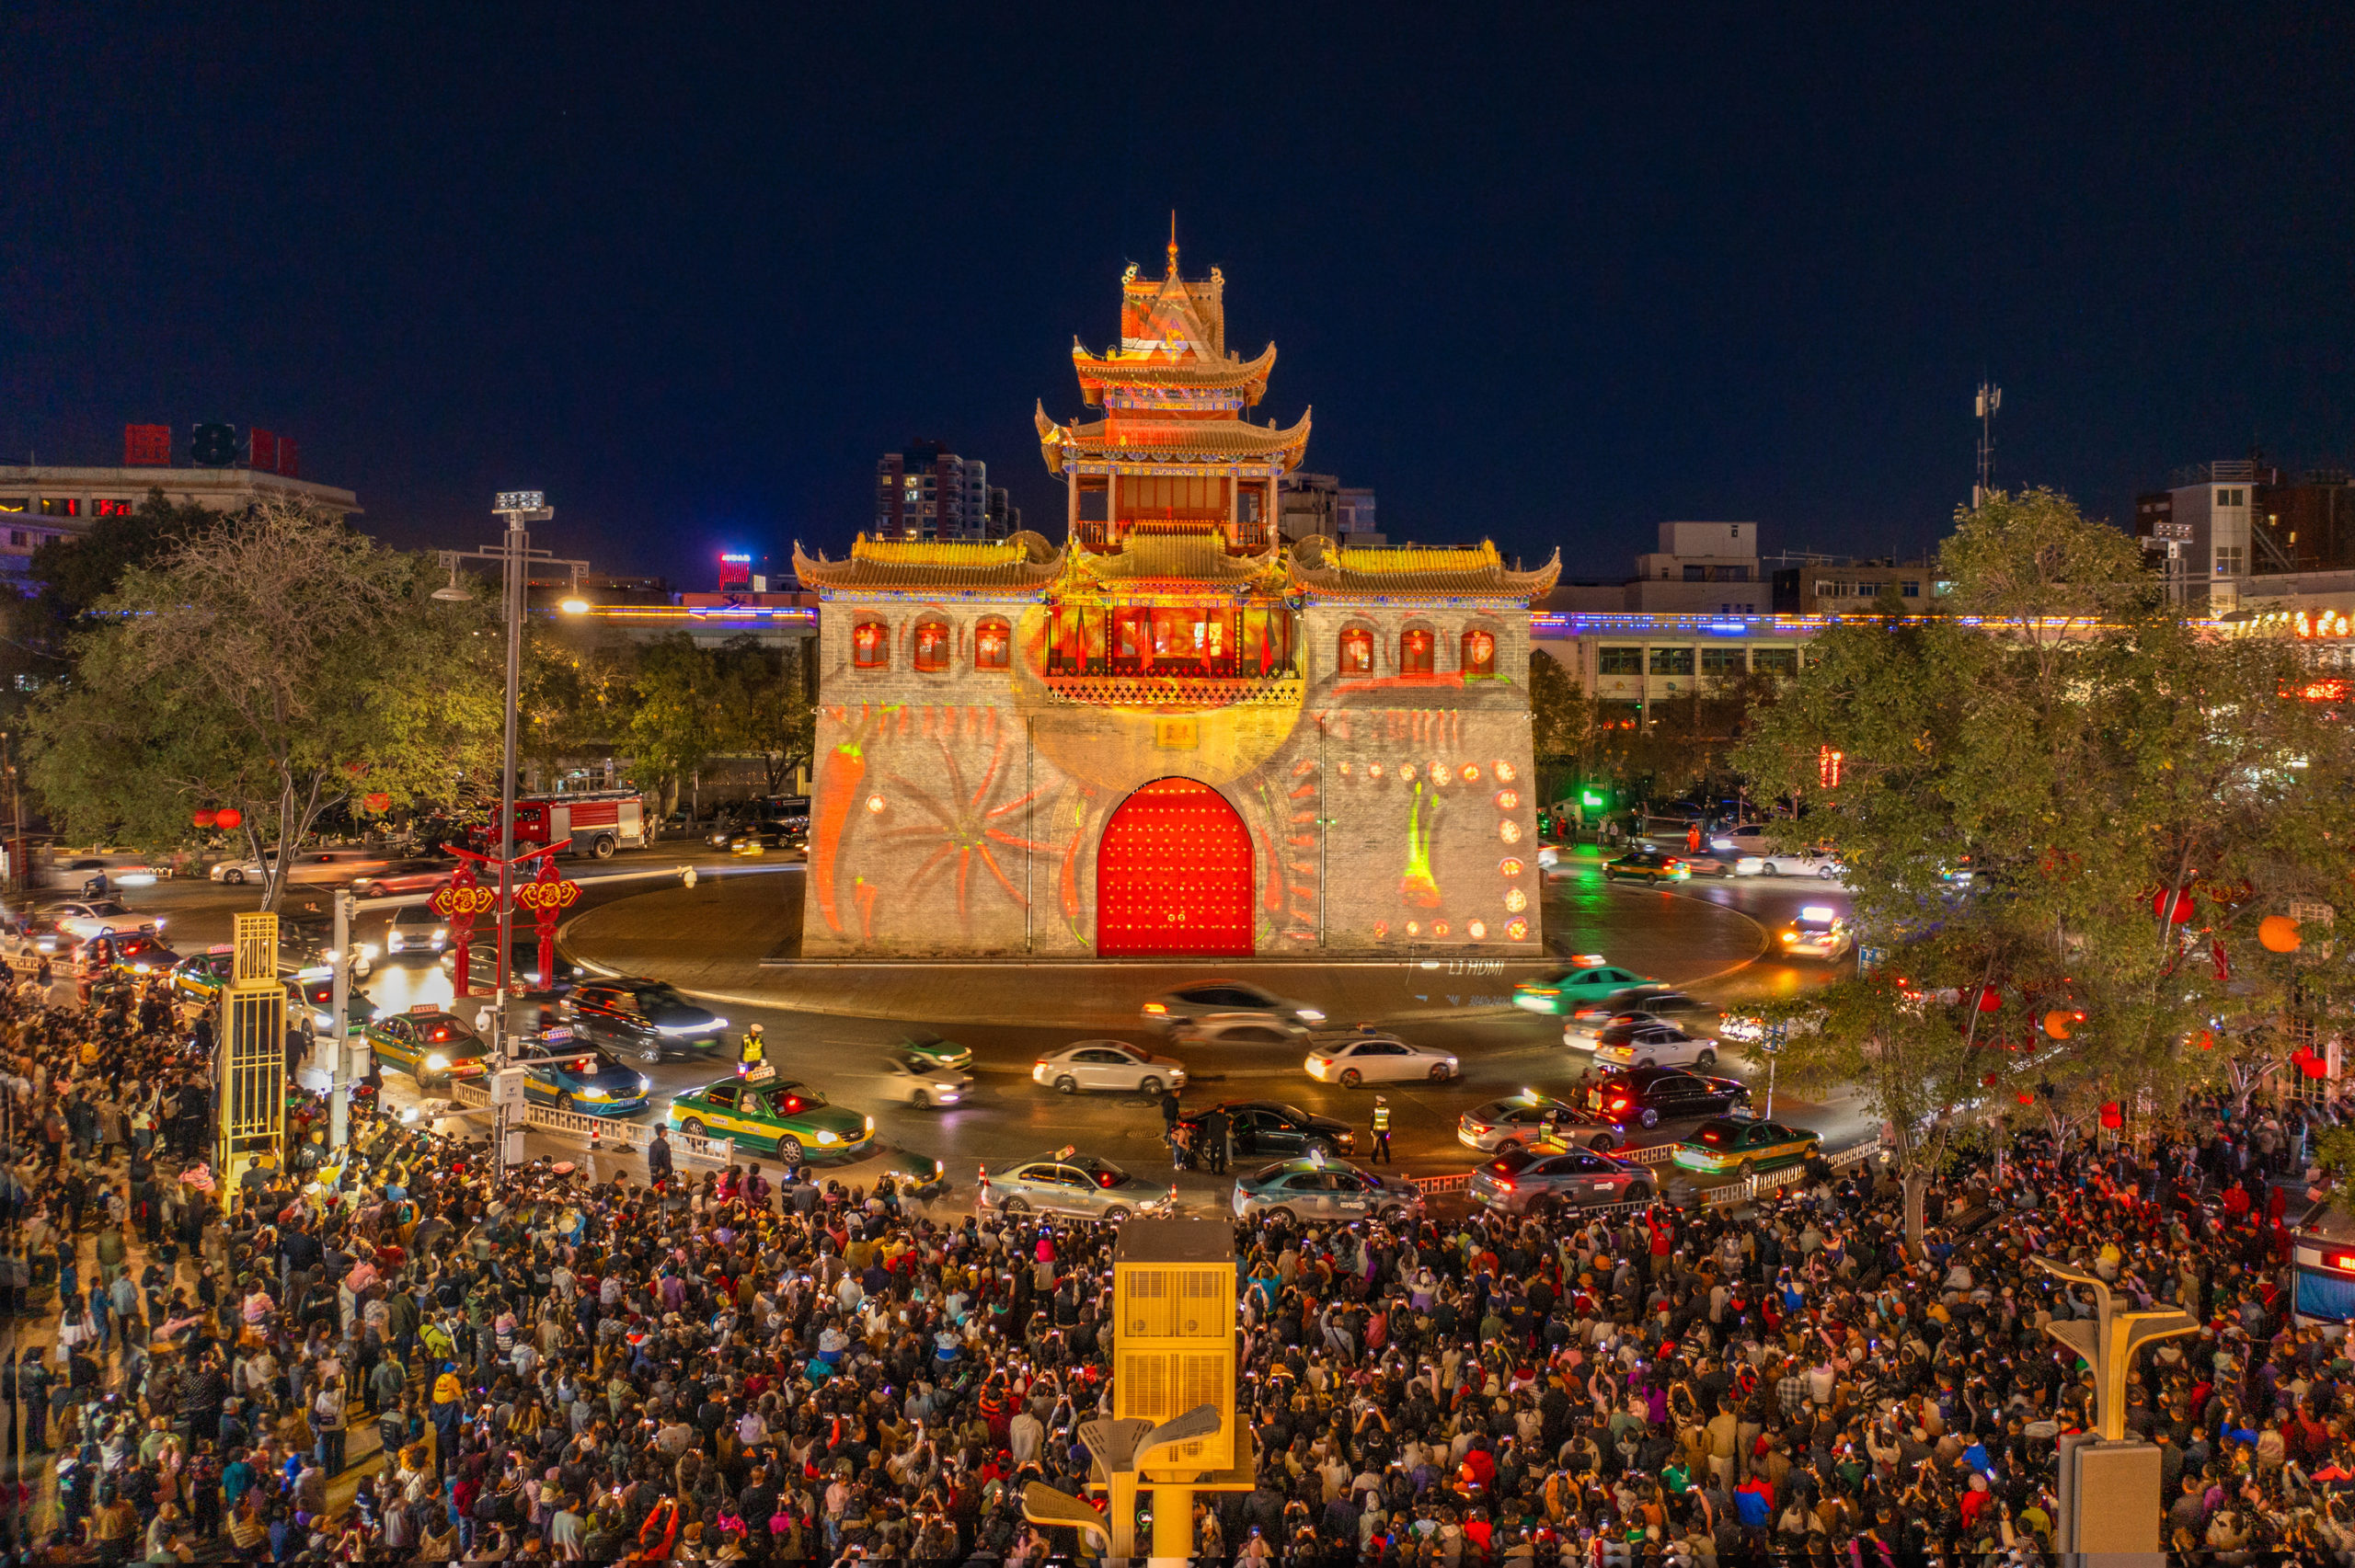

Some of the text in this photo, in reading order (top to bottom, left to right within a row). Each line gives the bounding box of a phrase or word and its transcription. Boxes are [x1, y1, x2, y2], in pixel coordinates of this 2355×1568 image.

[454, 889, 474, 910] 福
[540, 885, 558, 904] 福
[1466, 959, 1505, 977] HDMI
